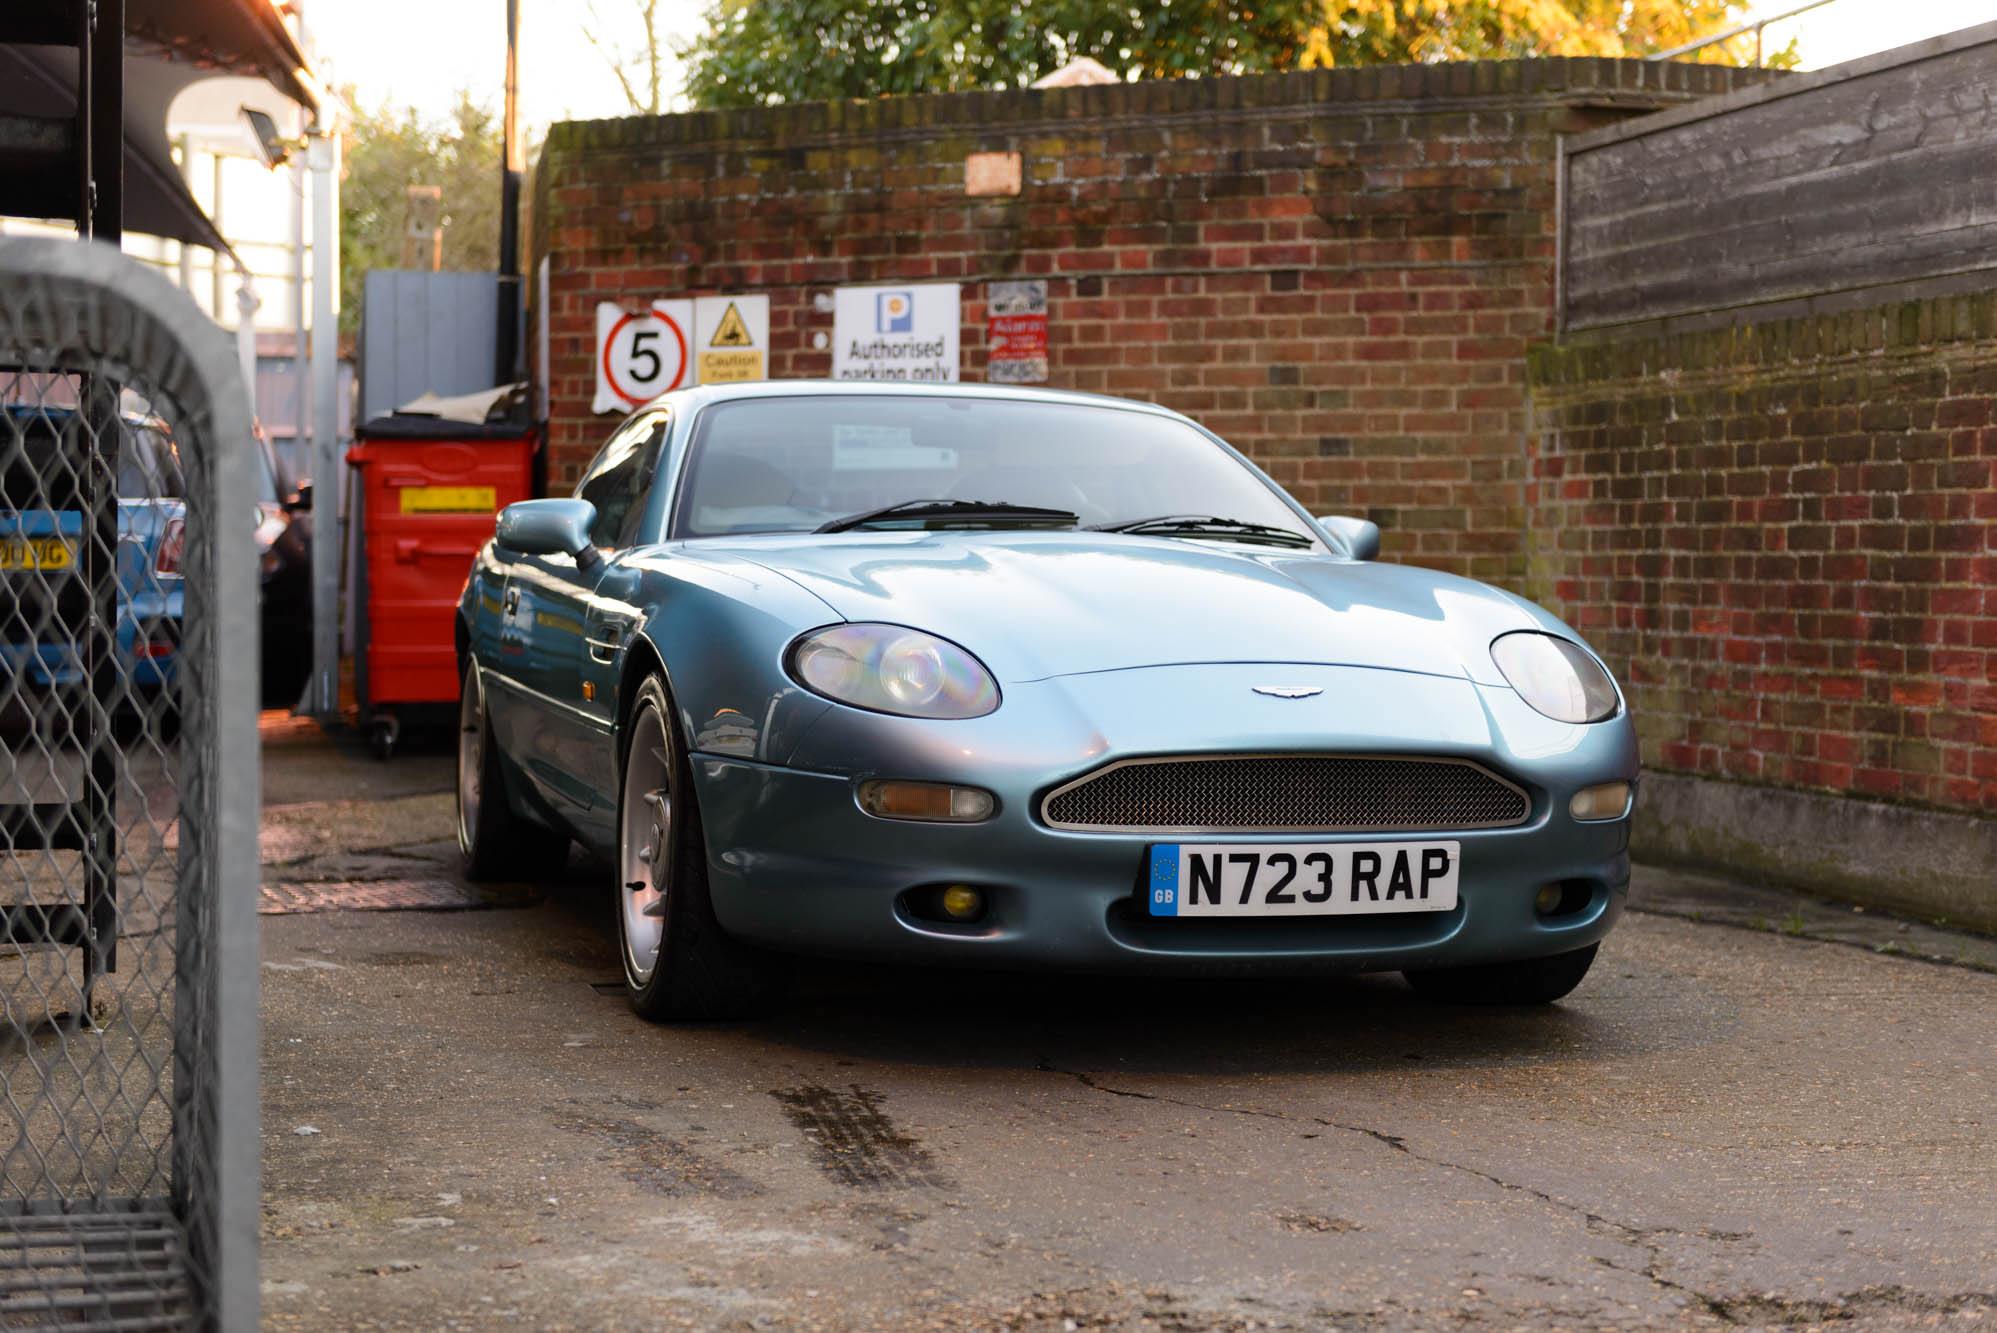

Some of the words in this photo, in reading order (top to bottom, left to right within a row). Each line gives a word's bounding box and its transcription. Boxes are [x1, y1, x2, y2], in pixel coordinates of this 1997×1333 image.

[629, 331, 661, 383] 5
[849, 336, 945, 360] Authorised
[705, 354, 758, 368] Caution
[842, 362, 907, 380] parking
[911, 360, 951, 381] only
[1189, 852, 1334, 905] N723
[1350, 848, 1450, 902] RAP
[1154, 889, 1174, 903] GB
